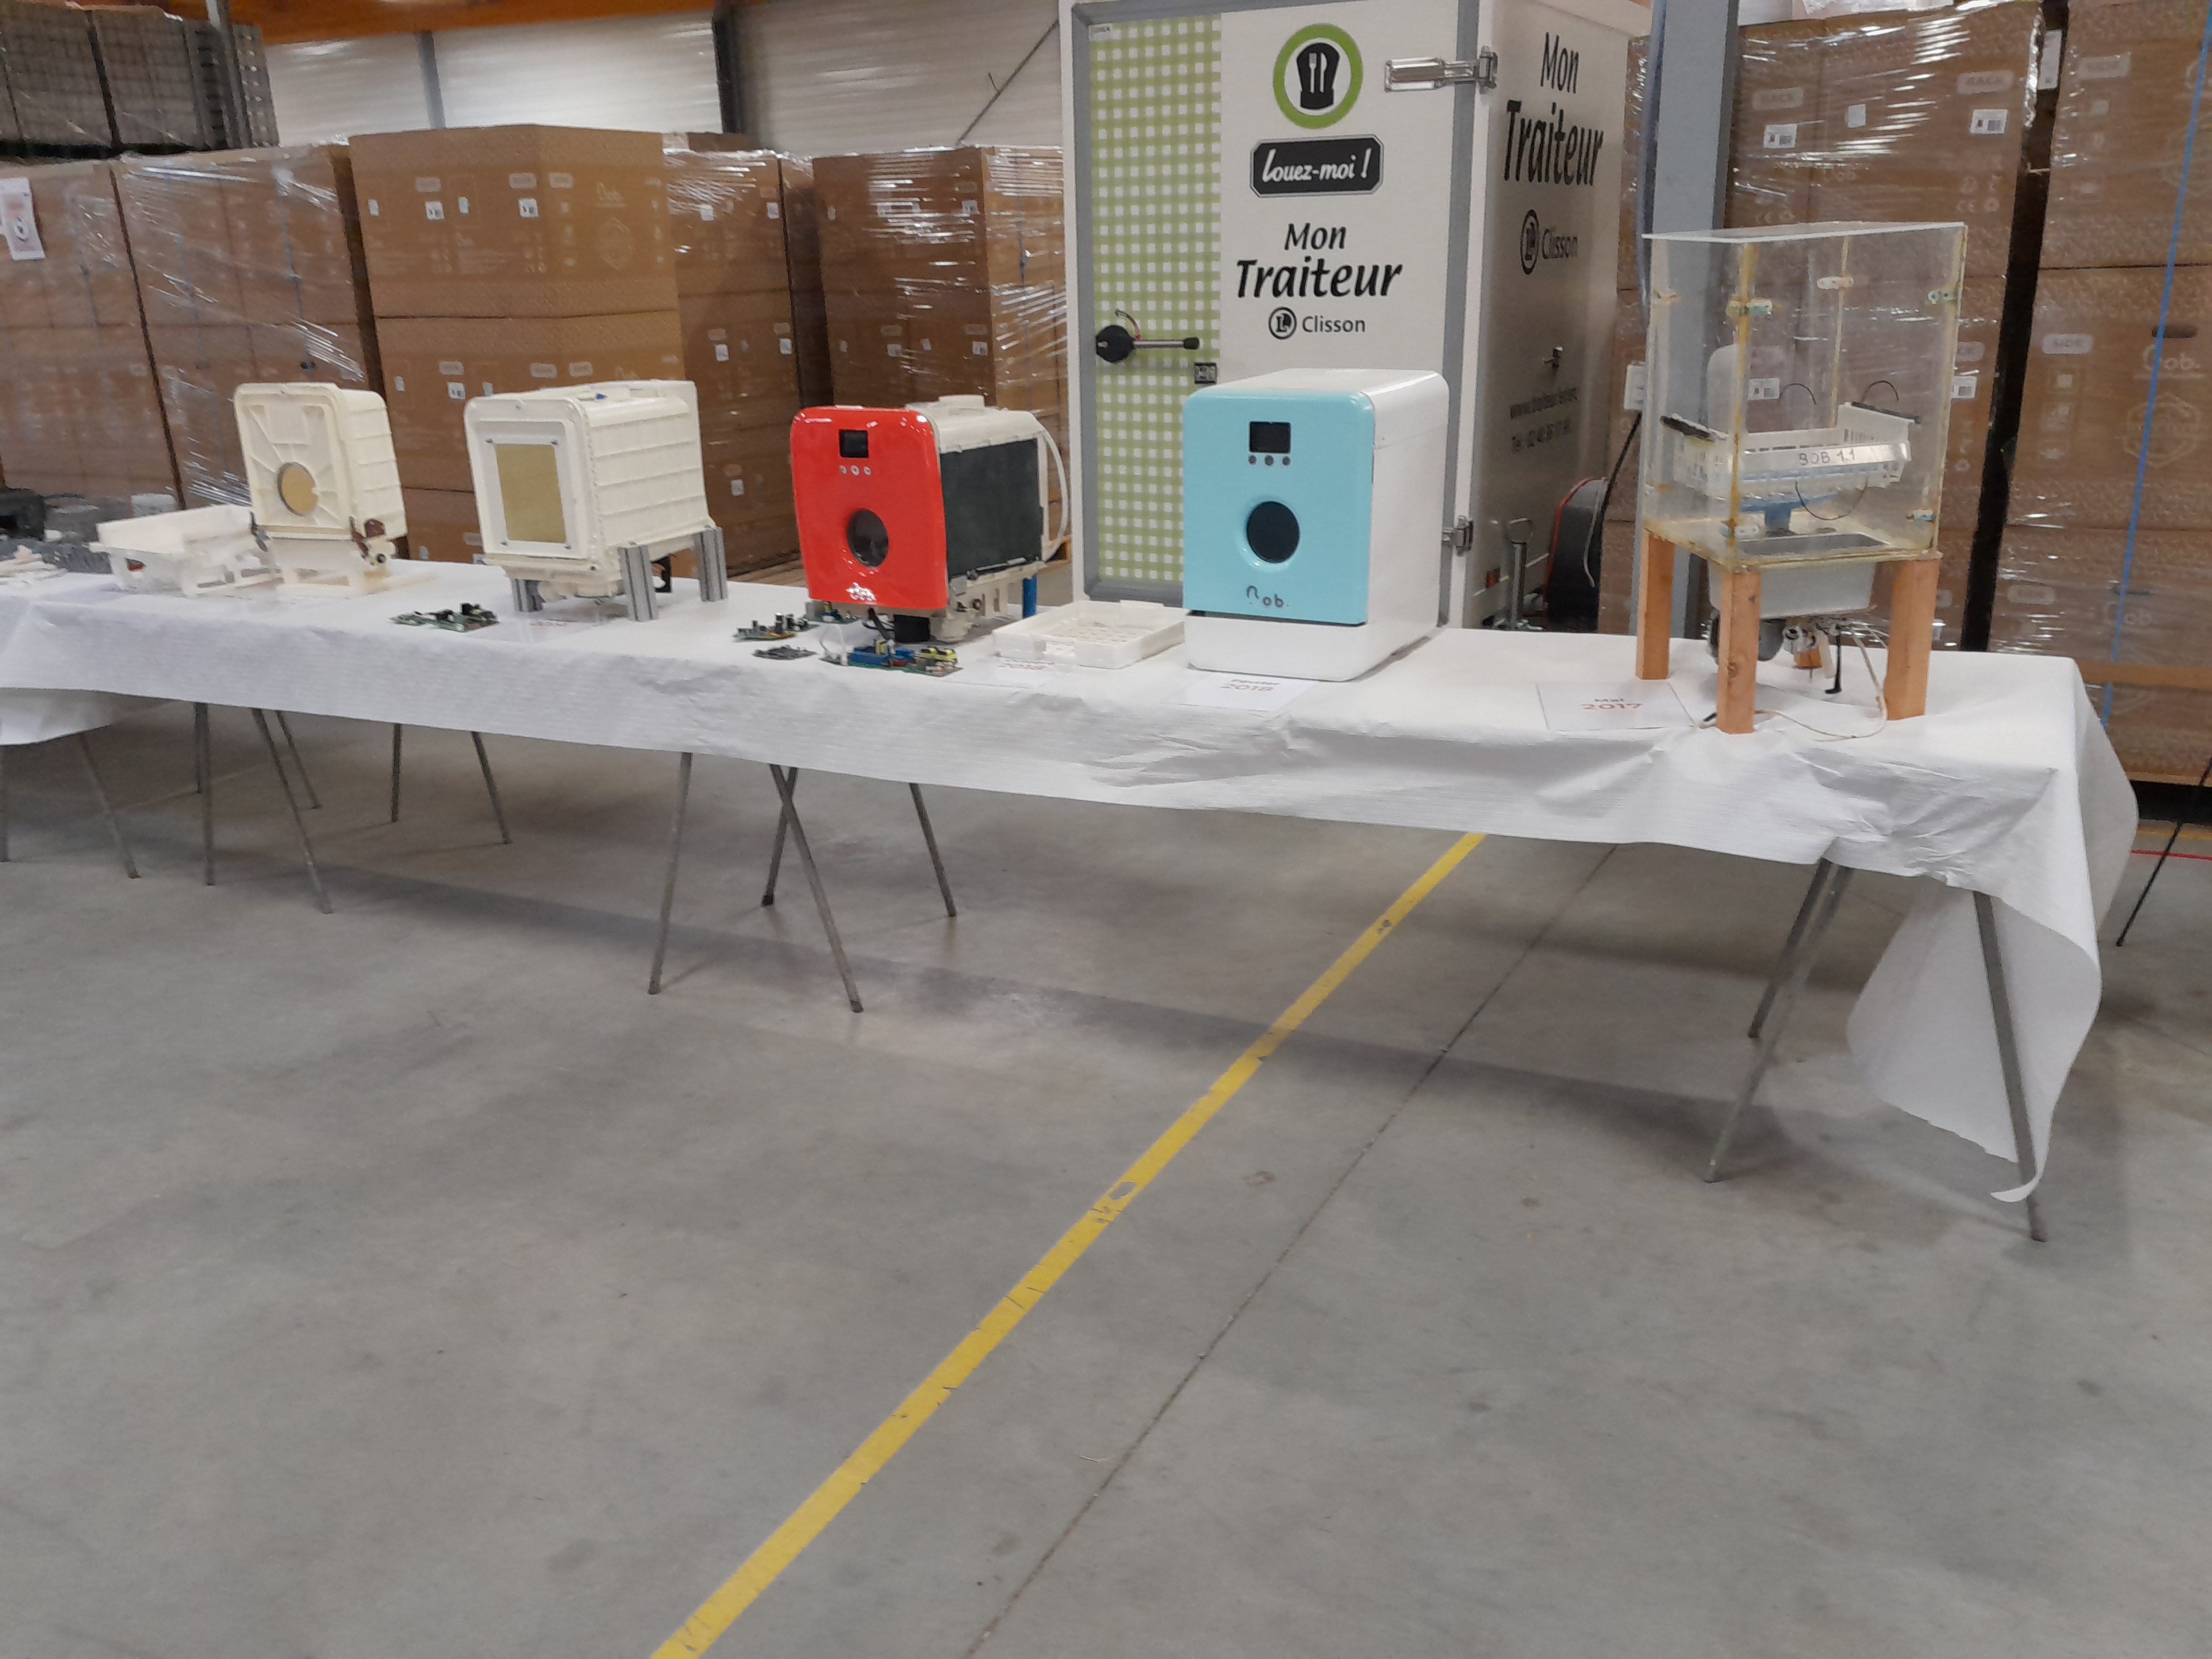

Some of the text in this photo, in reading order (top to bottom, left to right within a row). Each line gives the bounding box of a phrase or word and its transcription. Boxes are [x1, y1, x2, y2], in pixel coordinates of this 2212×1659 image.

[1540, 31, 1580, 95] Mon
[1503, 99, 1604, 186] Traiteur
[1284, 222, 1347, 251] Mon
[1237, 255, 1404, 298] Traiteur
[1302, 315, 1366, 333] Clisson
